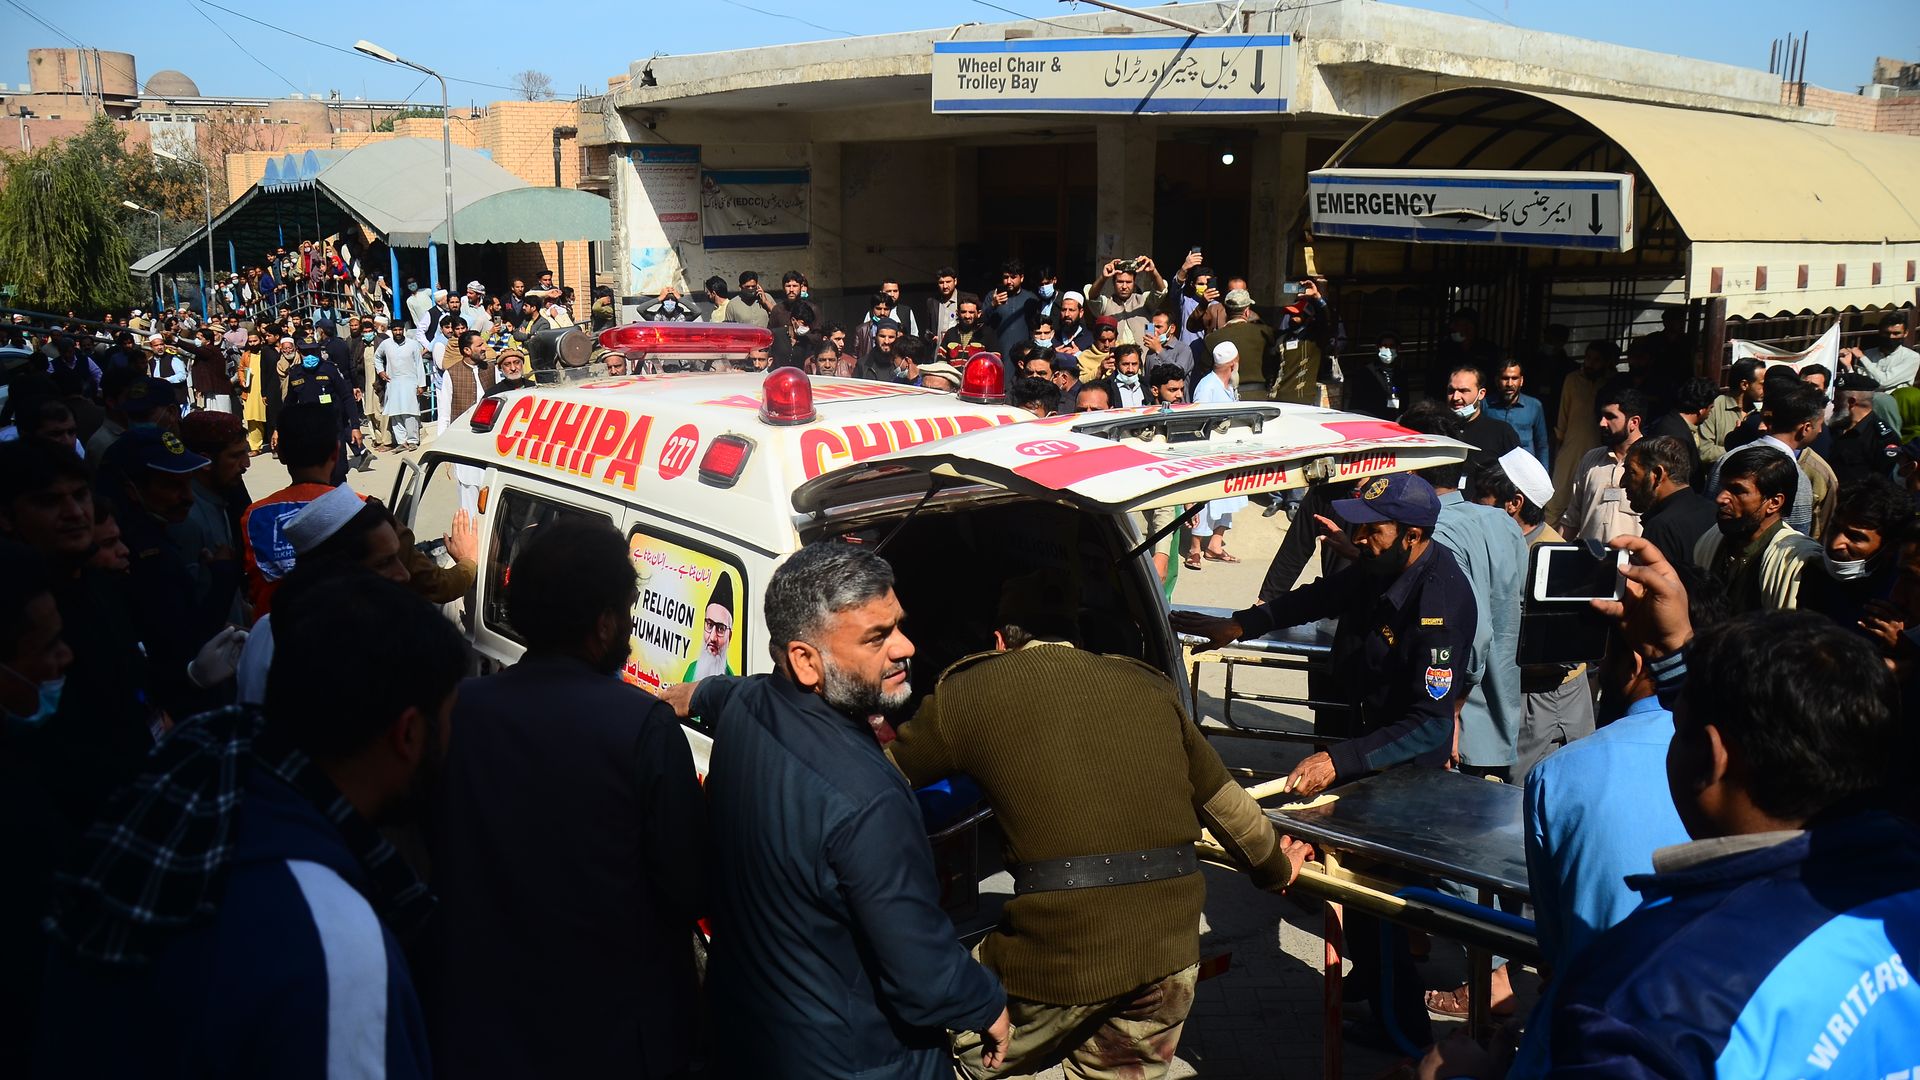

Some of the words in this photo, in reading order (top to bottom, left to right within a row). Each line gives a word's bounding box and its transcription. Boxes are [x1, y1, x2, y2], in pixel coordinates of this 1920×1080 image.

[958, 57, 1002, 73] Wheel
[1007, 57, 1046, 73] Chair
[1051, 56, 1062, 73] &
[1200, 51, 1238, 90] ویل
[957, 74, 1007, 93] Trolley
[1011, 74, 1039, 93] Bay
[1316, 193, 1437, 216] EMERGENCY
[1512, 190, 1572, 227] ایمرجنسی
[496, 395, 655, 491] CHHIPA
[661, 435, 697, 470] 277
[1023, 440, 1068, 455] 277
[1144, 463, 1191, 479] 24
[1223, 463, 1288, 494] CHHIPA
[1340, 451, 1397, 476] CHHIPA
[642, 588, 695, 628] RELIGION
[631, 615, 690, 659] HUMANITY
[1806, 953, 1909, 1071] WRITERS
